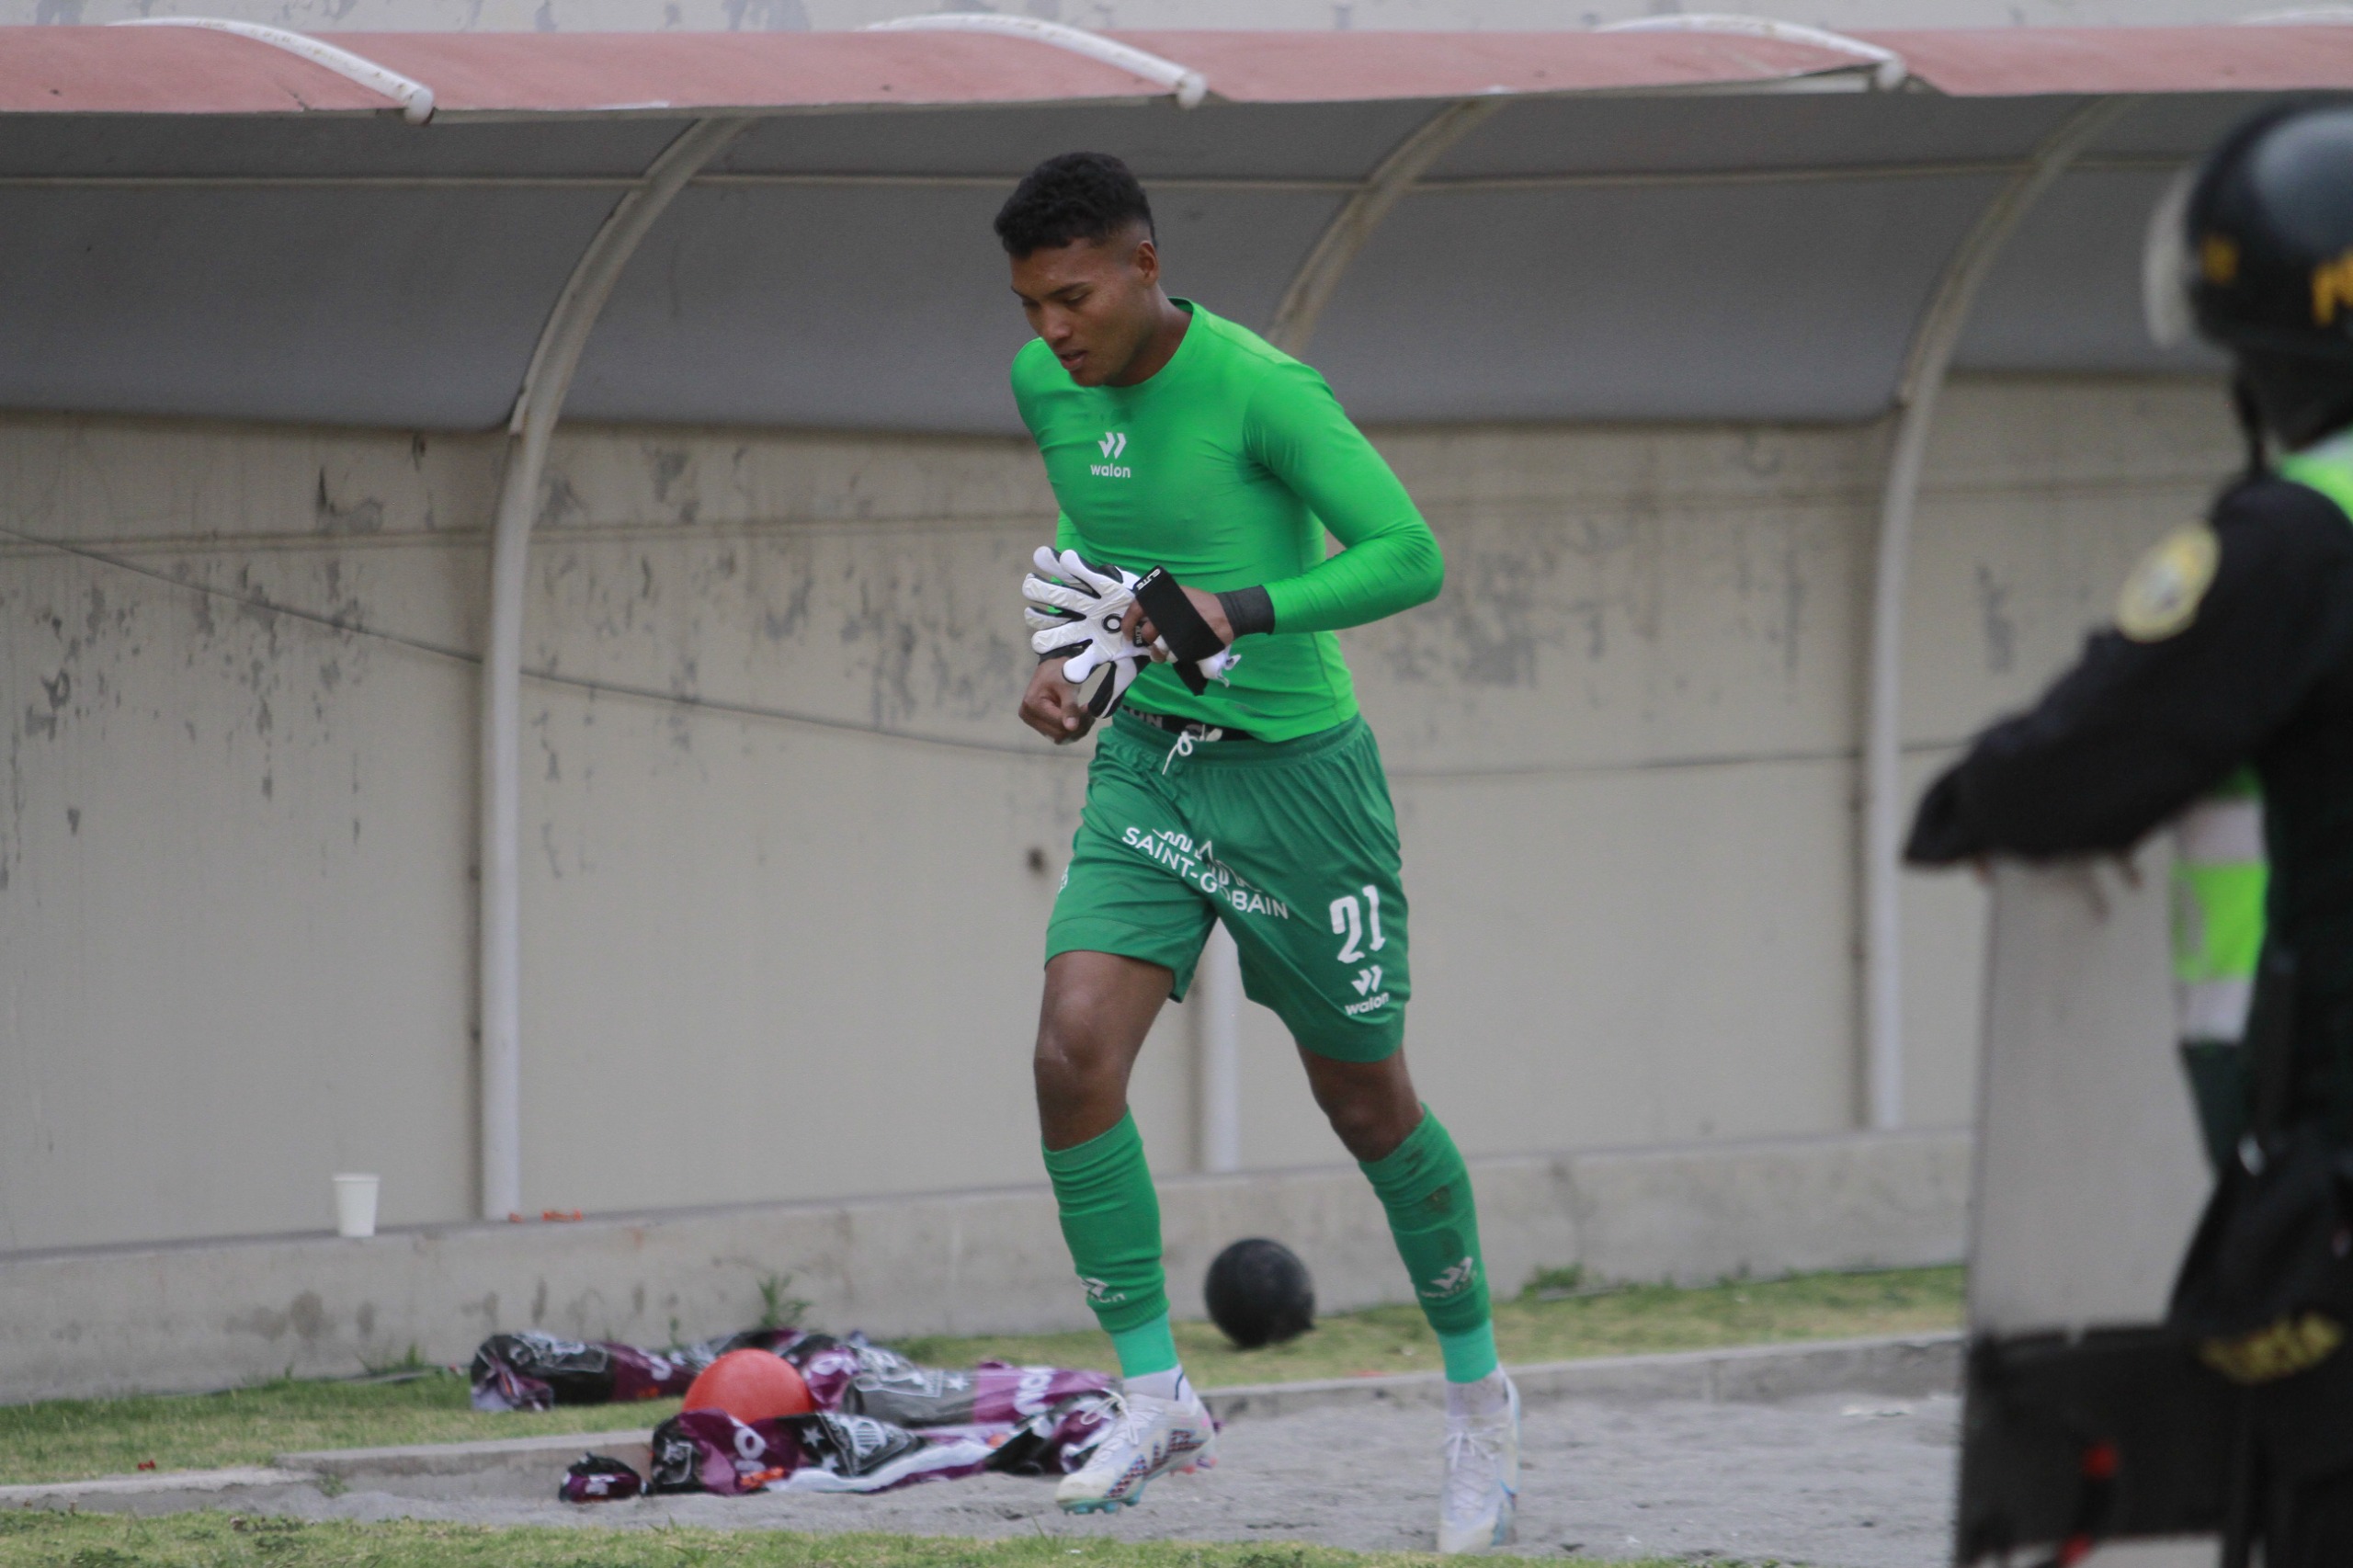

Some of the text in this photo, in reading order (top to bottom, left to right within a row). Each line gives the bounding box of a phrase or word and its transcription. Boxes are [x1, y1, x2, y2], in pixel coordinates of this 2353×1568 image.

[1090, 463, 1131, 478] walon
[1329, 884, 1386, 964] 21
[1345, 992, 1390, 1016] walon
